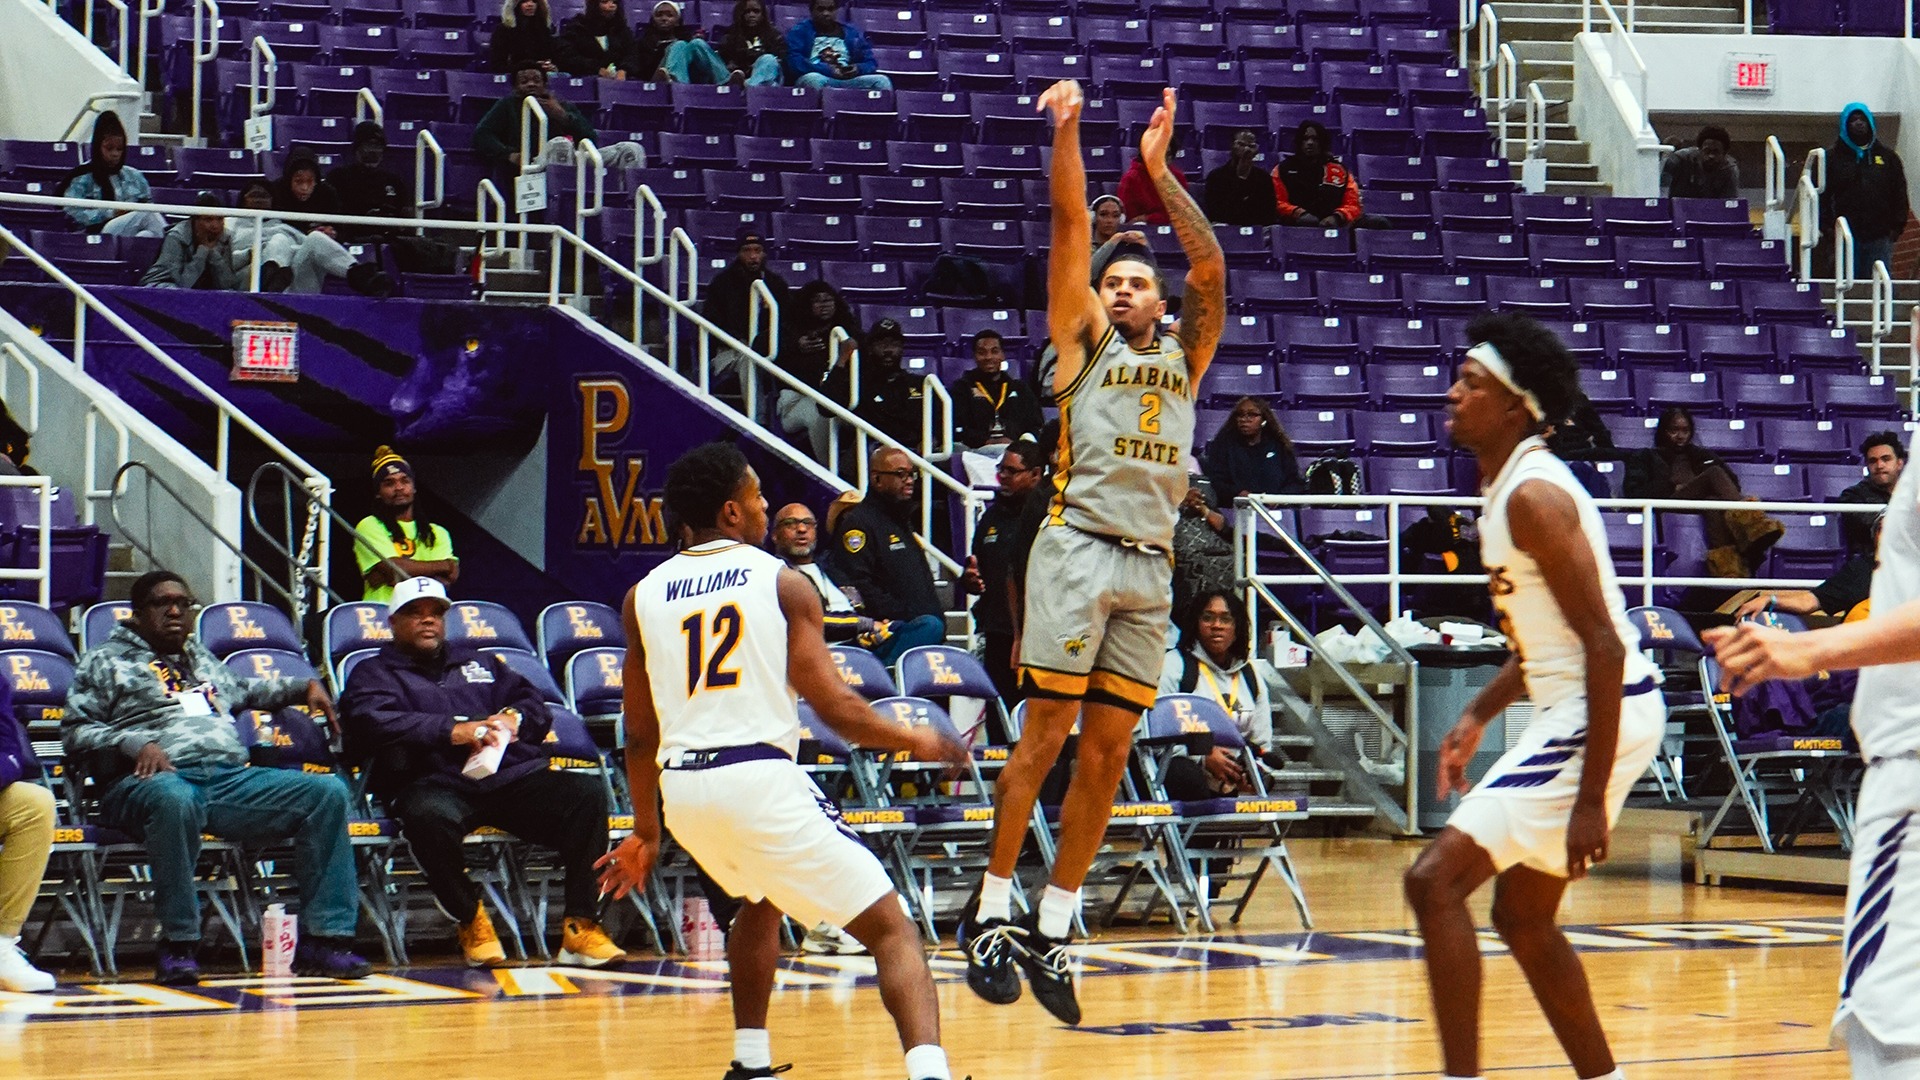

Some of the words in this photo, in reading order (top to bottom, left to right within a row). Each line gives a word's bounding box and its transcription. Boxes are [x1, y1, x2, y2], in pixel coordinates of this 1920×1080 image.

[1737, 62, 1768, 87] EXIT
[247, 335, 292, 367] EXIT
[1138, 391, 1161, 435] 2
[1114, 437, 1179, 465] STATE
[417, 578, 430, 592] P
[666, 568, 752, 602] WILLIAMS
[680, 601, 745, 701] 12
[1793, 739, 1842, 751] PANTHERS
[843, 811, 905, 824] PANTHERS
[1111, 804, 1173, 817] PANTHERS
[1235, 801, 1297, 813] PANTHERS
